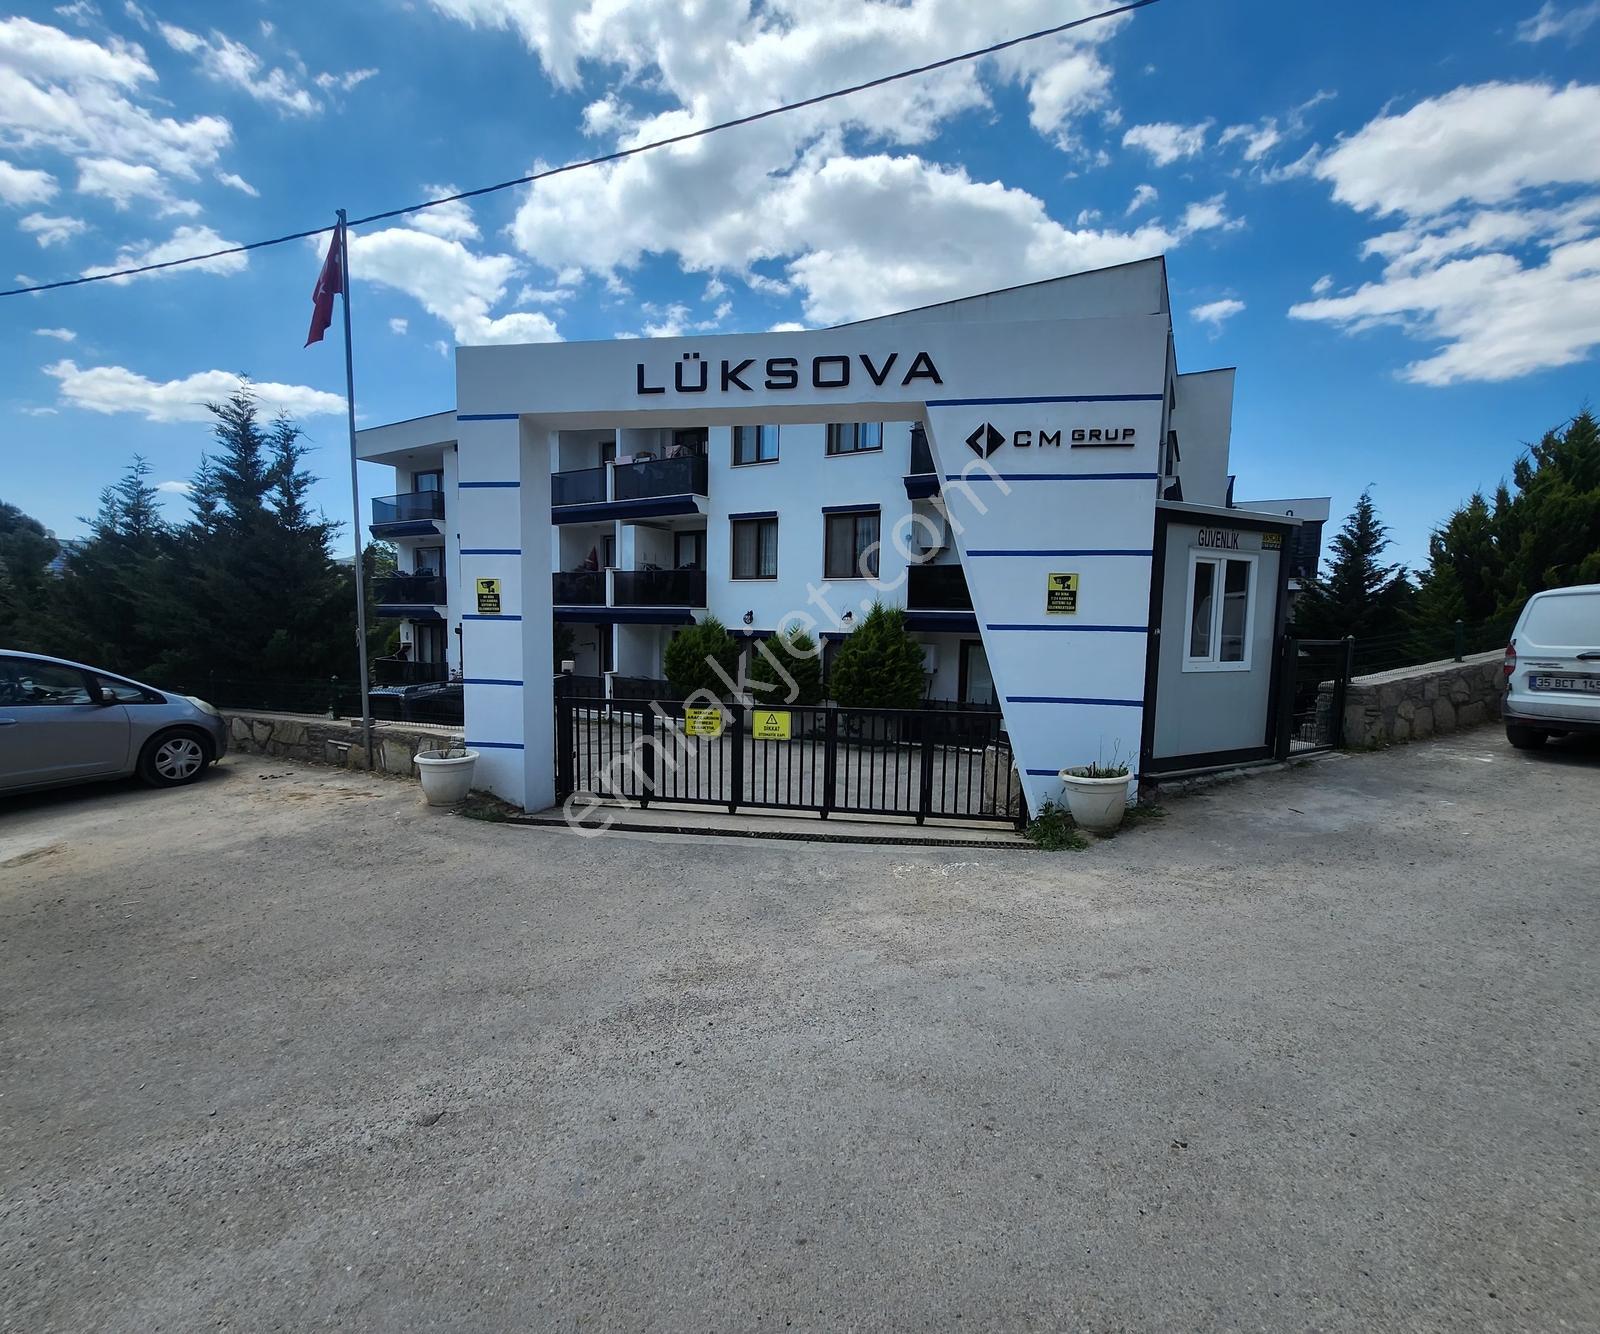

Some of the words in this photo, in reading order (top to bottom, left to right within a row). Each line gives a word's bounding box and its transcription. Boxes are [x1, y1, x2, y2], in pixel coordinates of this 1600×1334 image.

[636, 351, 944, 395] LÜKSOVA
[1013, 430, 1062, 448] CM
[1071, 428, 1136, 441] GRUP
[1537, 678, 1551, 687] 35
